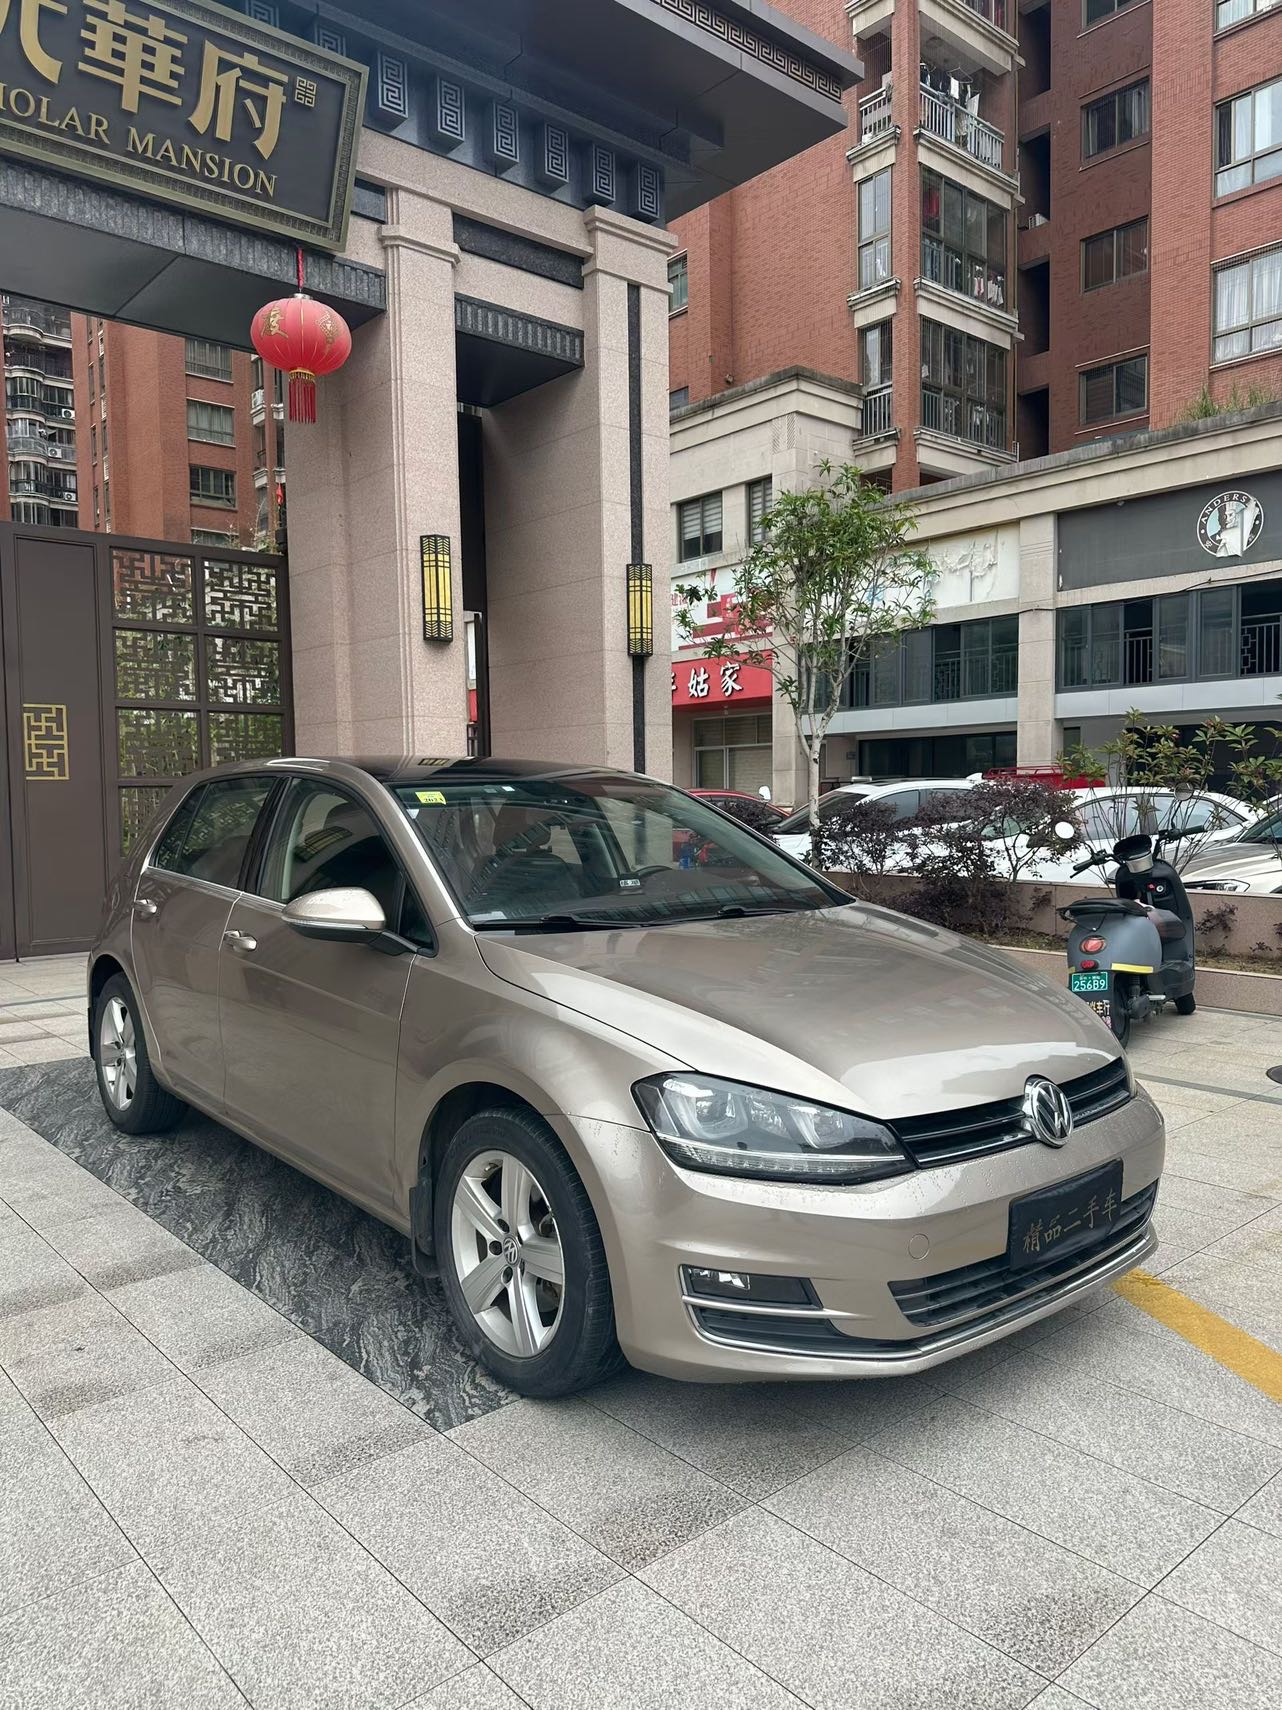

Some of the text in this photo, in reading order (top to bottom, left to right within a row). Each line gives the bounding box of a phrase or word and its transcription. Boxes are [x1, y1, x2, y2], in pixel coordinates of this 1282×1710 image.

[127, 126, 278, 198] MANSION
[1201, 492, 1249, 525] ANDERS
[1022, 1187, 1118, 1253] 精品二手车
